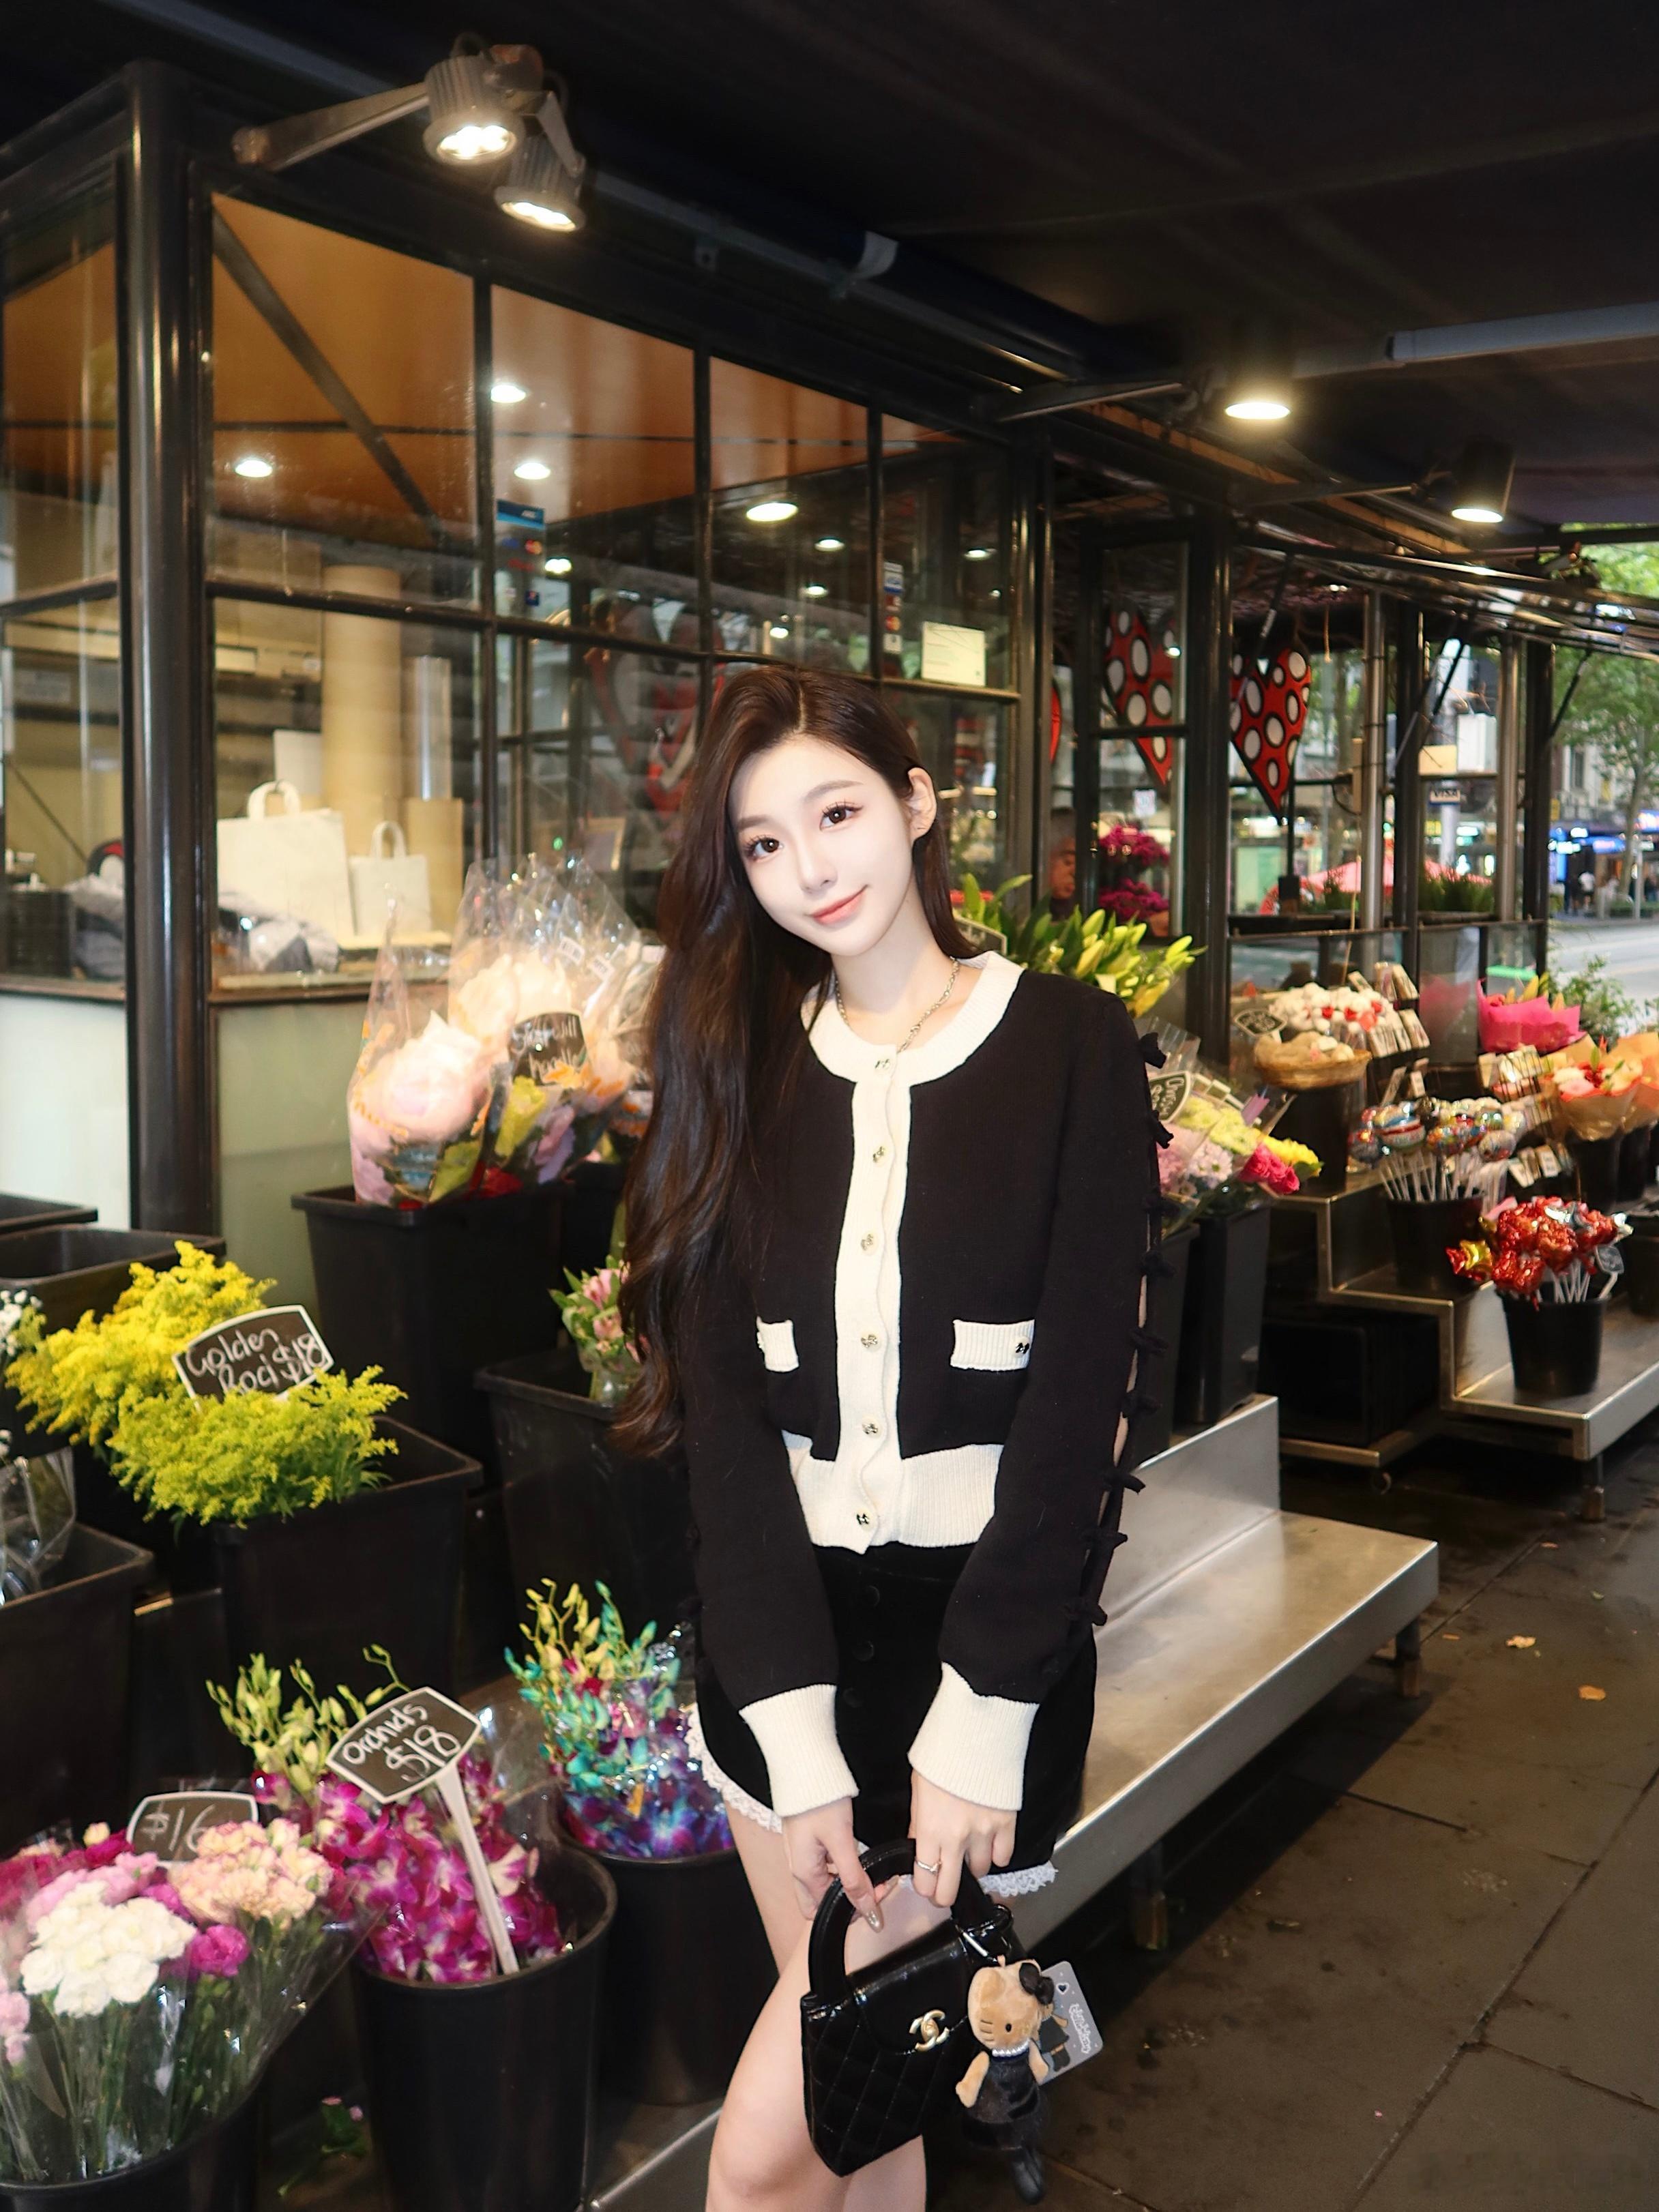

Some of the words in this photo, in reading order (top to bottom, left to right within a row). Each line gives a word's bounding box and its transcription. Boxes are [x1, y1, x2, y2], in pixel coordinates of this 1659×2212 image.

[186, 1329, 279, 1377] Golden
[218, 1353, 280, 1396] Rod
[271, 1333, 326, 1385] $18
[342, 1703, 428, 1765] Orchids
[383, 1724, 461, 1782] $18
